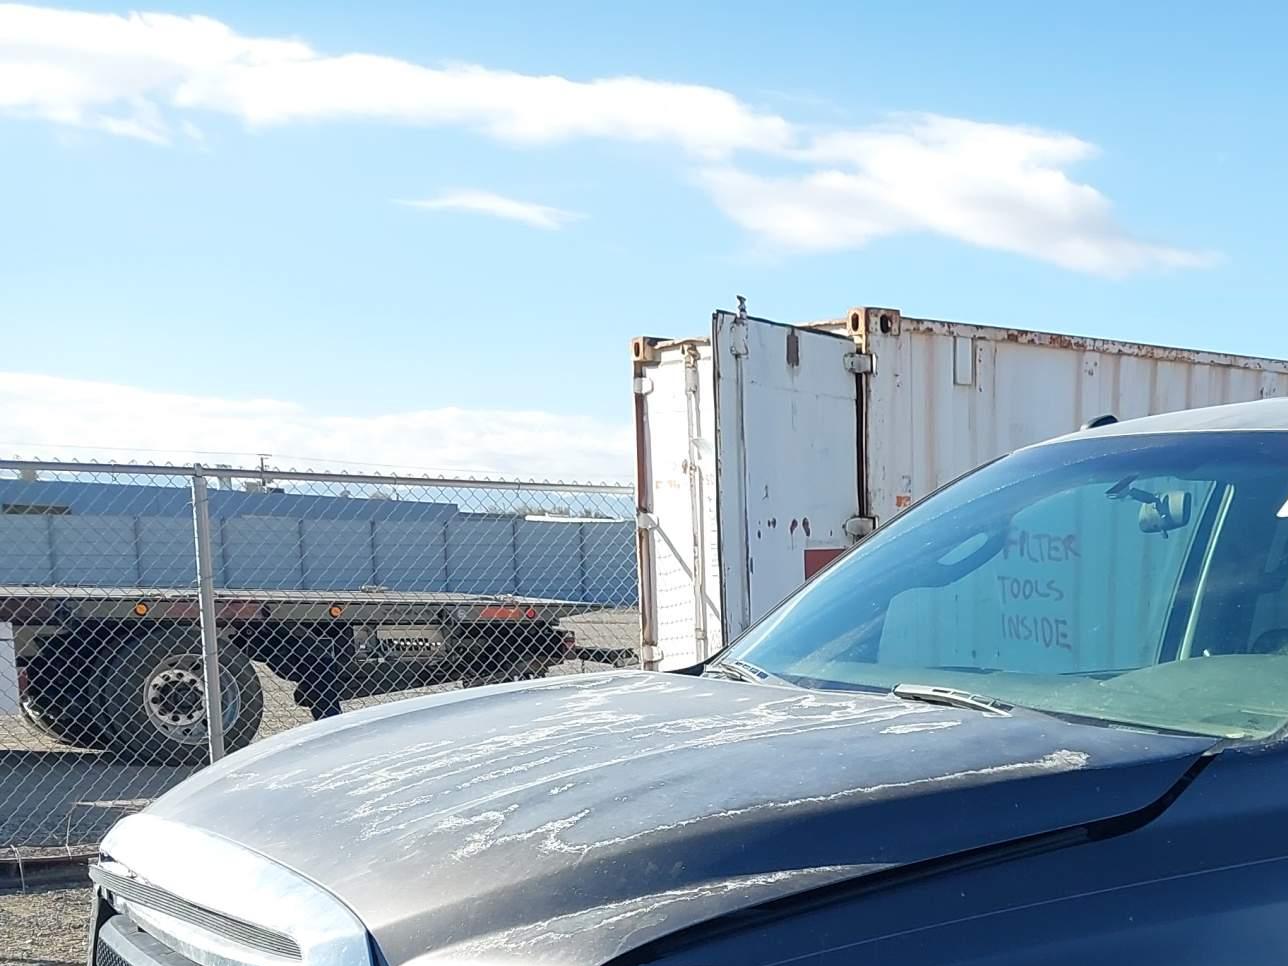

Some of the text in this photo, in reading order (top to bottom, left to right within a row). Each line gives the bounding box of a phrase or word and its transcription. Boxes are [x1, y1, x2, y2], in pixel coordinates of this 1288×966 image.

[1002, 530, 1082, 562] FILTER
[997, 576, 1064, 604] TOOLS
[1001, 613, 1073, 653] INSIDE
